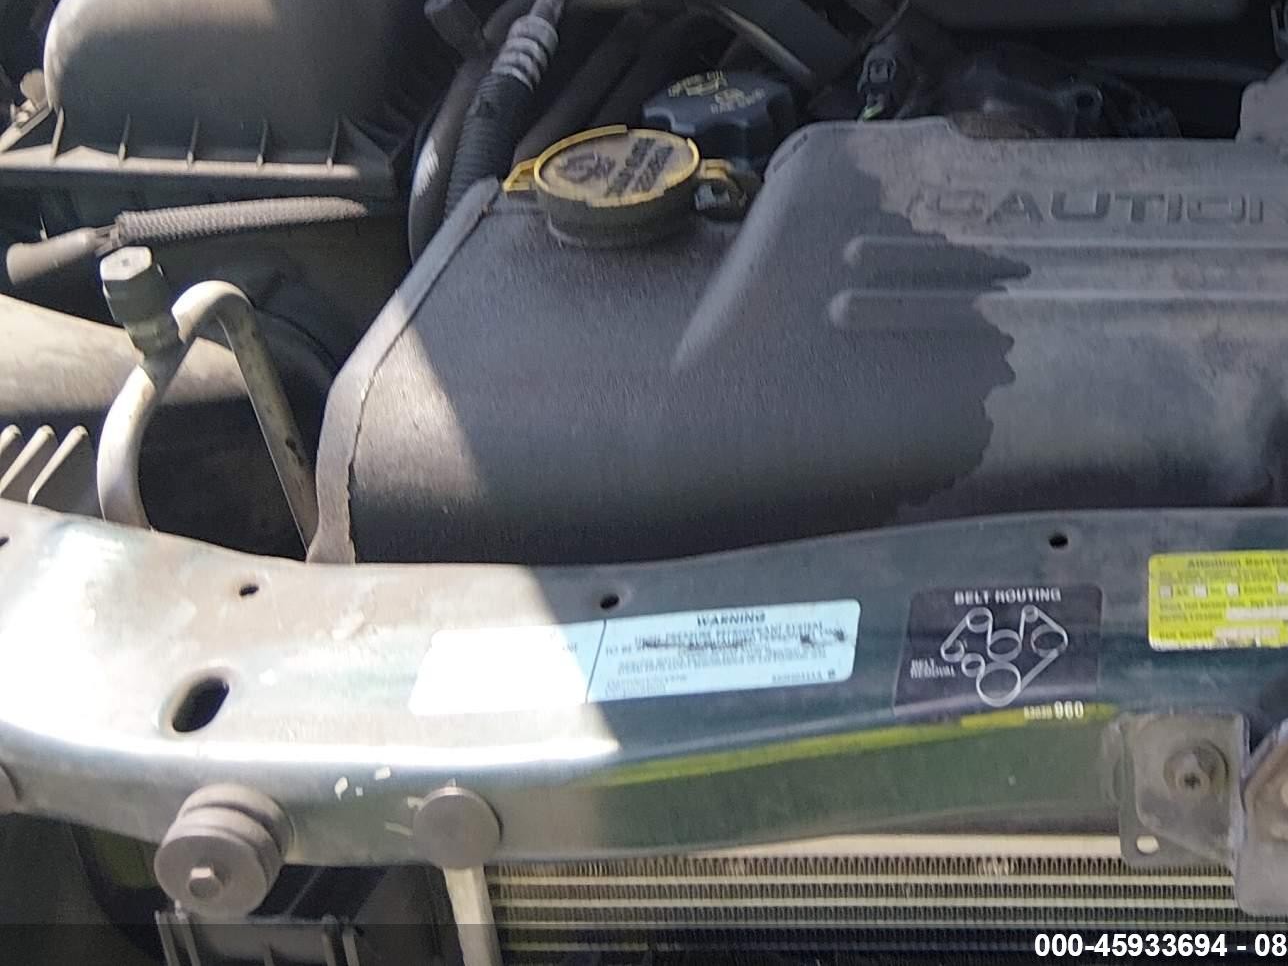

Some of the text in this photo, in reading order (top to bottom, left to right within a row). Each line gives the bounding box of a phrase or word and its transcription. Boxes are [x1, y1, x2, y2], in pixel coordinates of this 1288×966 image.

[954, 588, 1062, 605] BELT ROUTING
[696, 613, 766, 627] WARNING
